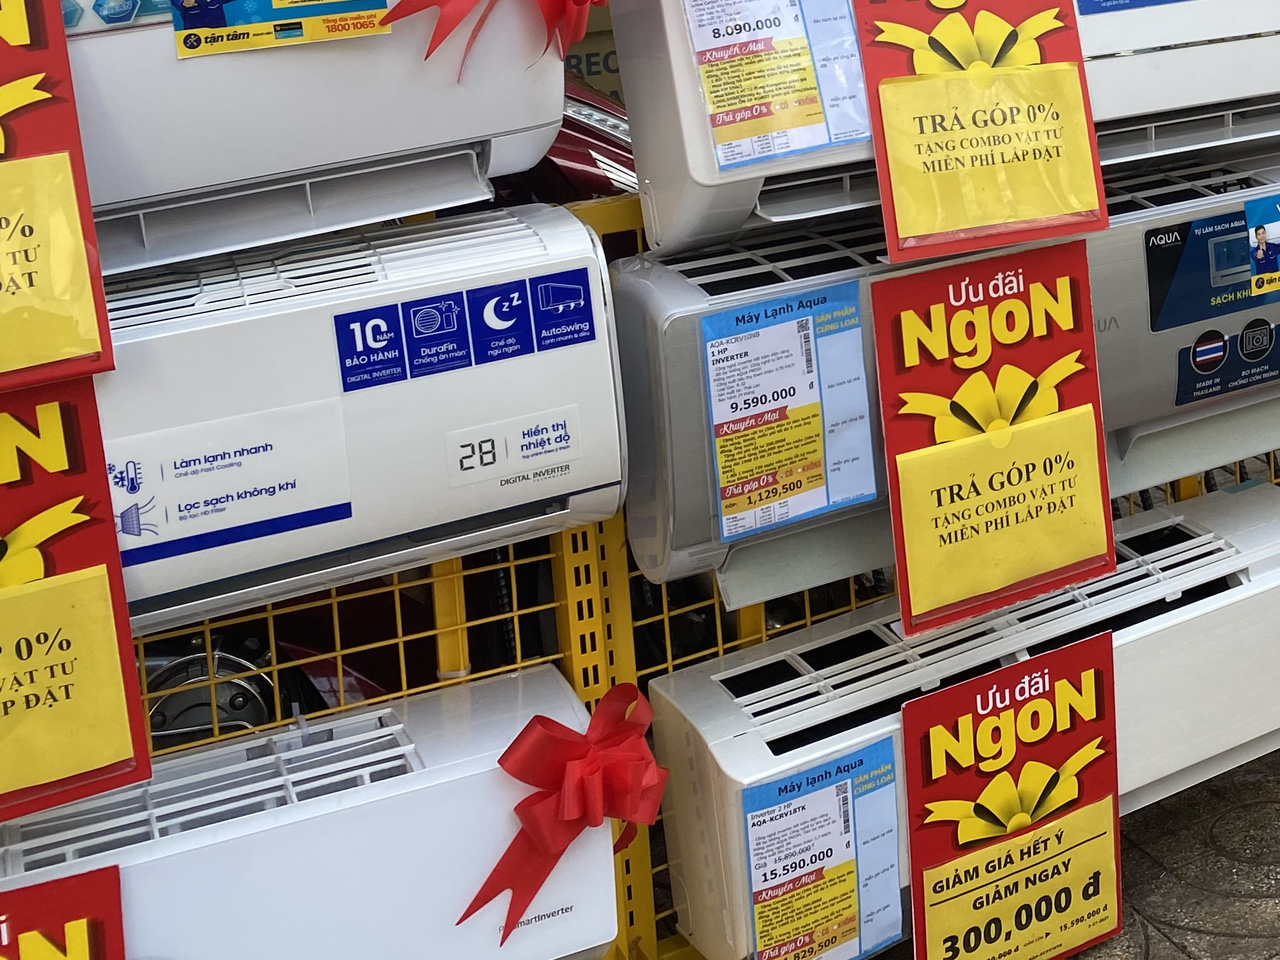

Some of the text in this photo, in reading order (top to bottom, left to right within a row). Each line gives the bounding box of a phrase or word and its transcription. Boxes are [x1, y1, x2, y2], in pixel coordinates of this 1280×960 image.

[326, 21, 375, 34] 1800 1065
[712, 17, 781, 40] 8.090.000
[1150, 232, 1180, 247] AQUA
[948, 269, 1024, 307] Ưu đãi
[1210, 291, 1234, 306] SẠCH
[735, 295, 827, 327] Máy Lạnh Aqua
[350, 318, 395, 352] 10 NĂM
[541, 321, 589, 338] AutoSwing
[346, 349, 399, 367] BẢO HÀNH
[420, 342, 457, 356] DuraFin
[712, 351, 749, 365] INVERTER
[730, 387, 796, 414] 9.590.000
[552, 420, 566, 434] thị
[459, 438, 496, 471] 28
[521, 432, 570, 452] nhiệt độ
[174, 443, 273, 470] Làm lạnh nhanh
[500, 464, 570, 486] DIGITAL INVERTER
[931, 452, 1075, 509] TRẢ GÓP 0%
[178, 479, 296, 513] Lọc sạch không khí
[746, 480, 803, 506] 1,129,500
[778, 758, 864, 797] Máy lạnh Aqua
[762, 848, 834, 883] 15.590.000
[932, 828, 1065, 894] GIẢM GIÁ HẾT Ý
[972, 858, 1072, 911] GIẢM NGAY
[942, 870, 1101, 960] 300,000 đ
[1059, 908, 1101, 933] 15,590,000
